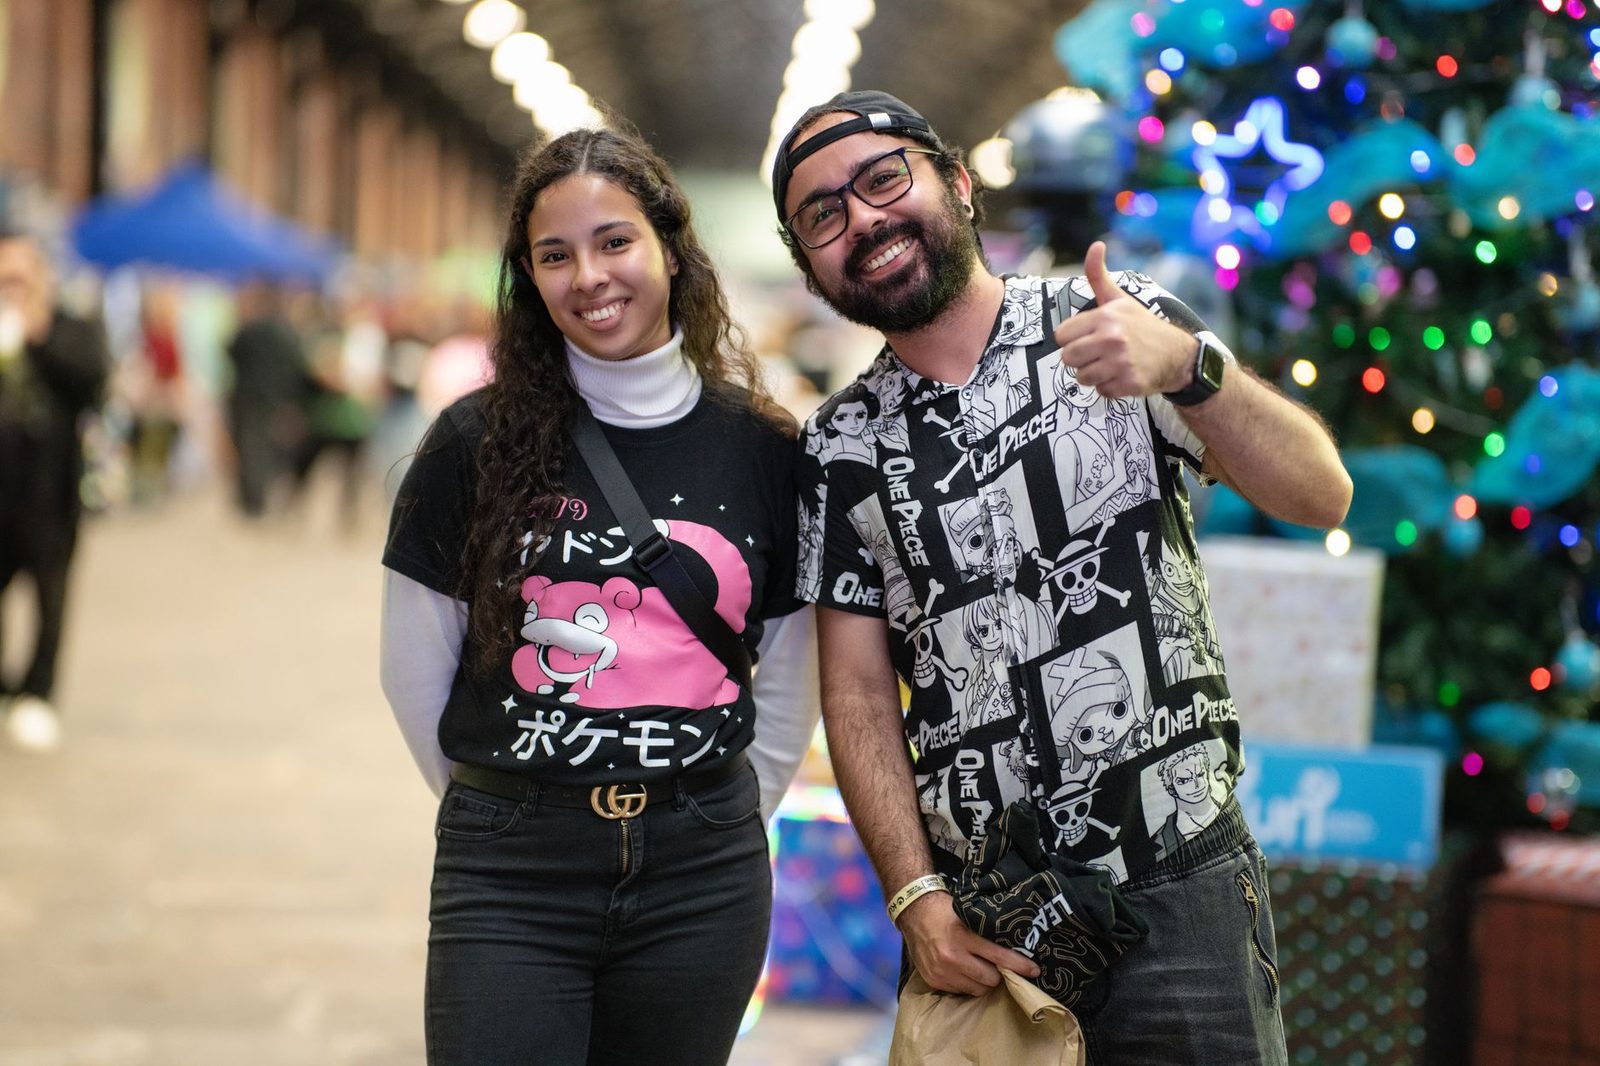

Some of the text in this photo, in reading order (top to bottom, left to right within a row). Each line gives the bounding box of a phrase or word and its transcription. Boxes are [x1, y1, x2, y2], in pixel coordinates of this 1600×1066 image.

[999, 401, 1057, 466] PIECE
[883, 456, 930, 566] ONE PIECE
[832, 571, 883, 608] ONE
[510, 710, 718, 767] ポケモン
[919, 719, 960, 757] PIECE
[1152, 691, 1239, 748] ONE PIECE
[955, 749, 985, 799] ONE
